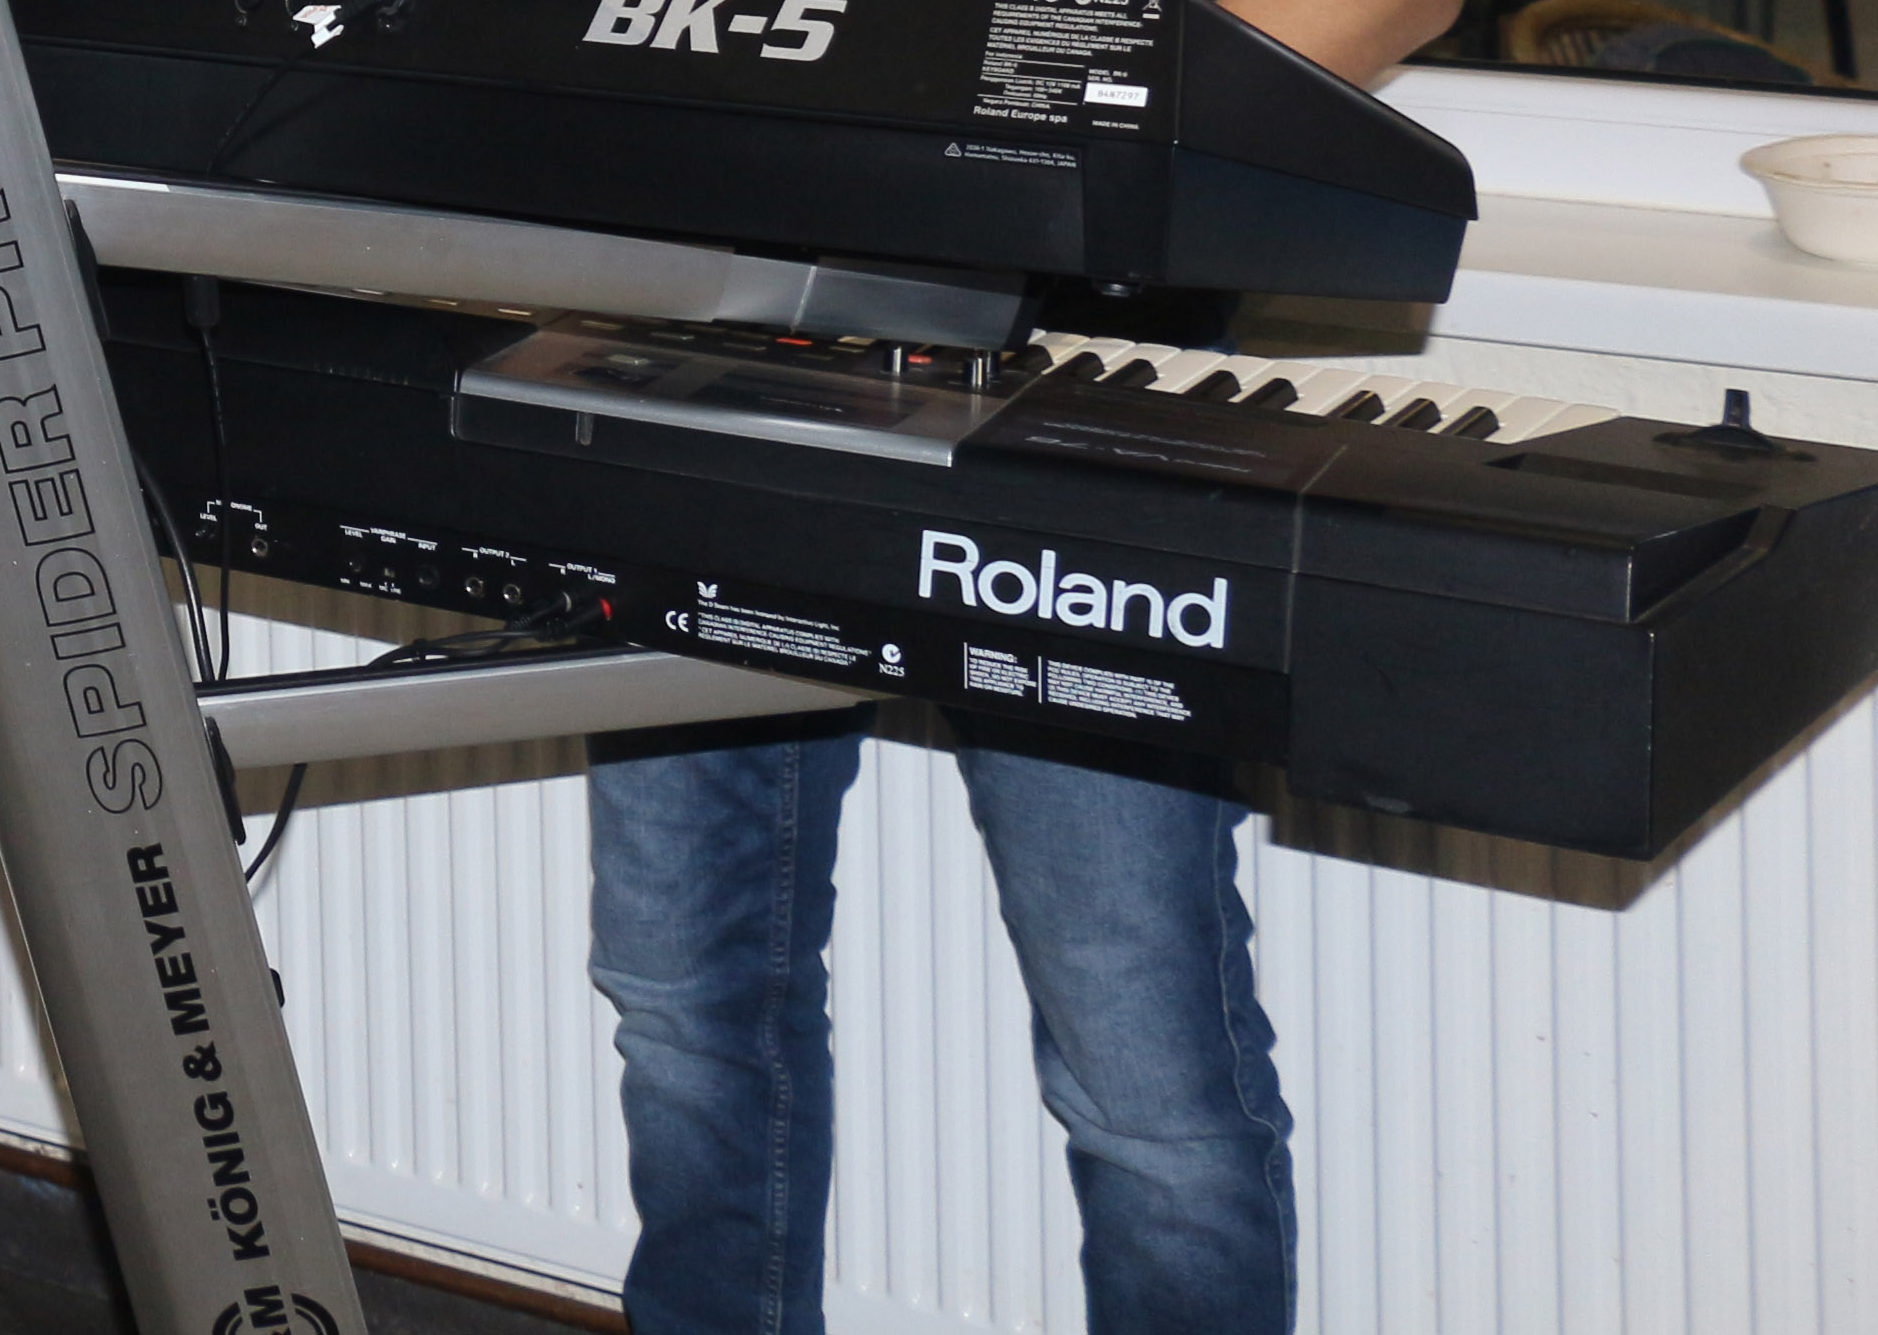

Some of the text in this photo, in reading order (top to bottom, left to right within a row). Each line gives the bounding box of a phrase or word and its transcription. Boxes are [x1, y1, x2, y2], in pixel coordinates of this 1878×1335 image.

[973, 105, 1068, 124] Roland Europe spa
[479, 546, 505, 558] OUTPUT
[567, 563, 592, 574] OUTPUT
[918, 529, 1228, 649] Roland
[665, 610, 689, 633] CE
[969, 646, 1018, 663] WARNING:
[879, 662, 905, 677] N225
[126, 841, 270, 1261] KÖNIG & MEYER
